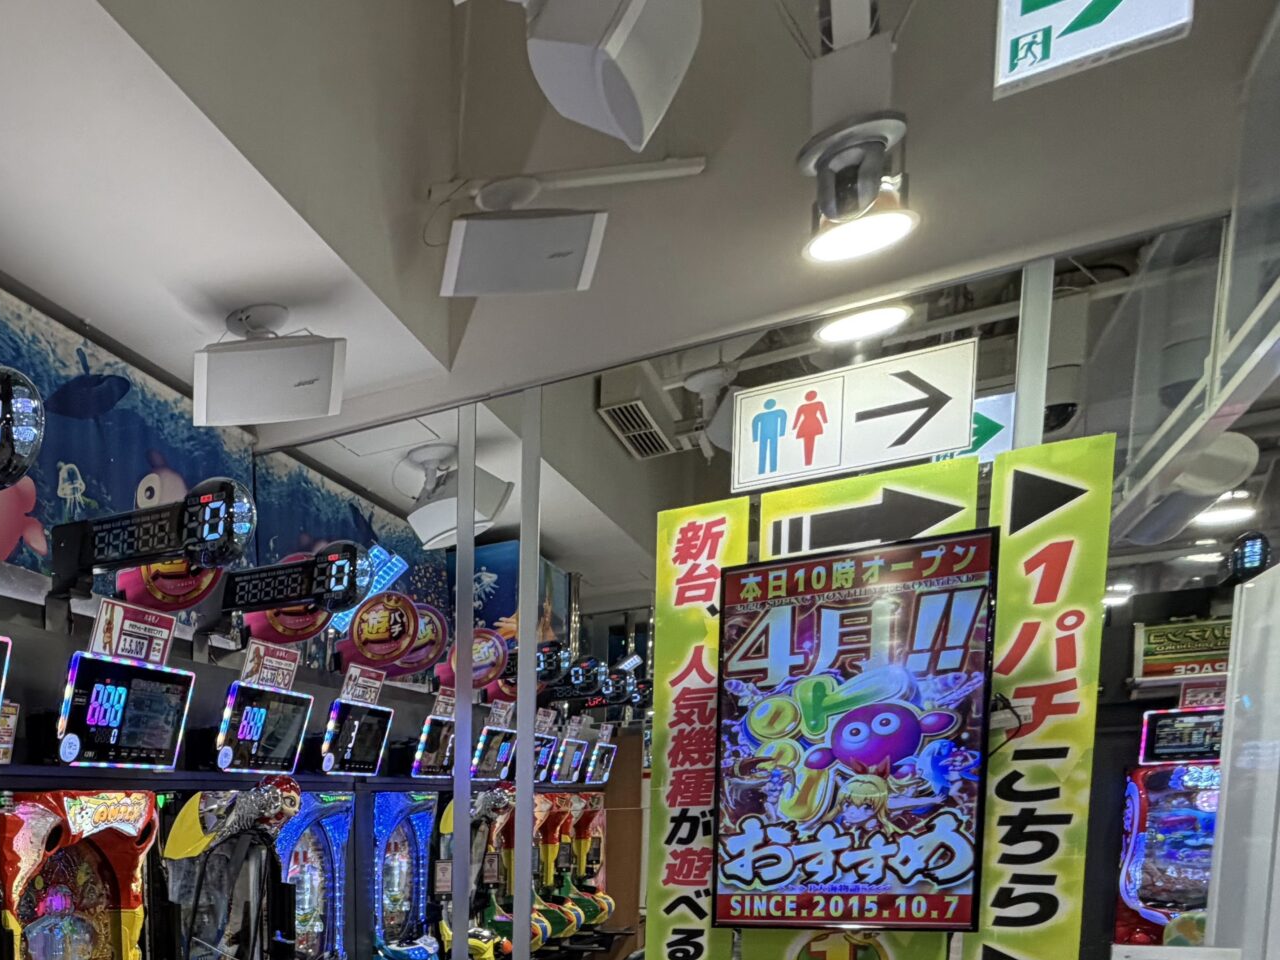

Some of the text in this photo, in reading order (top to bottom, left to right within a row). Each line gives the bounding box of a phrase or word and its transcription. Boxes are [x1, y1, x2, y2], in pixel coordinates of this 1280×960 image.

[740, 544, 977, 602] 本日10時オープン
[723, 815, 974, 885] おすすめ
